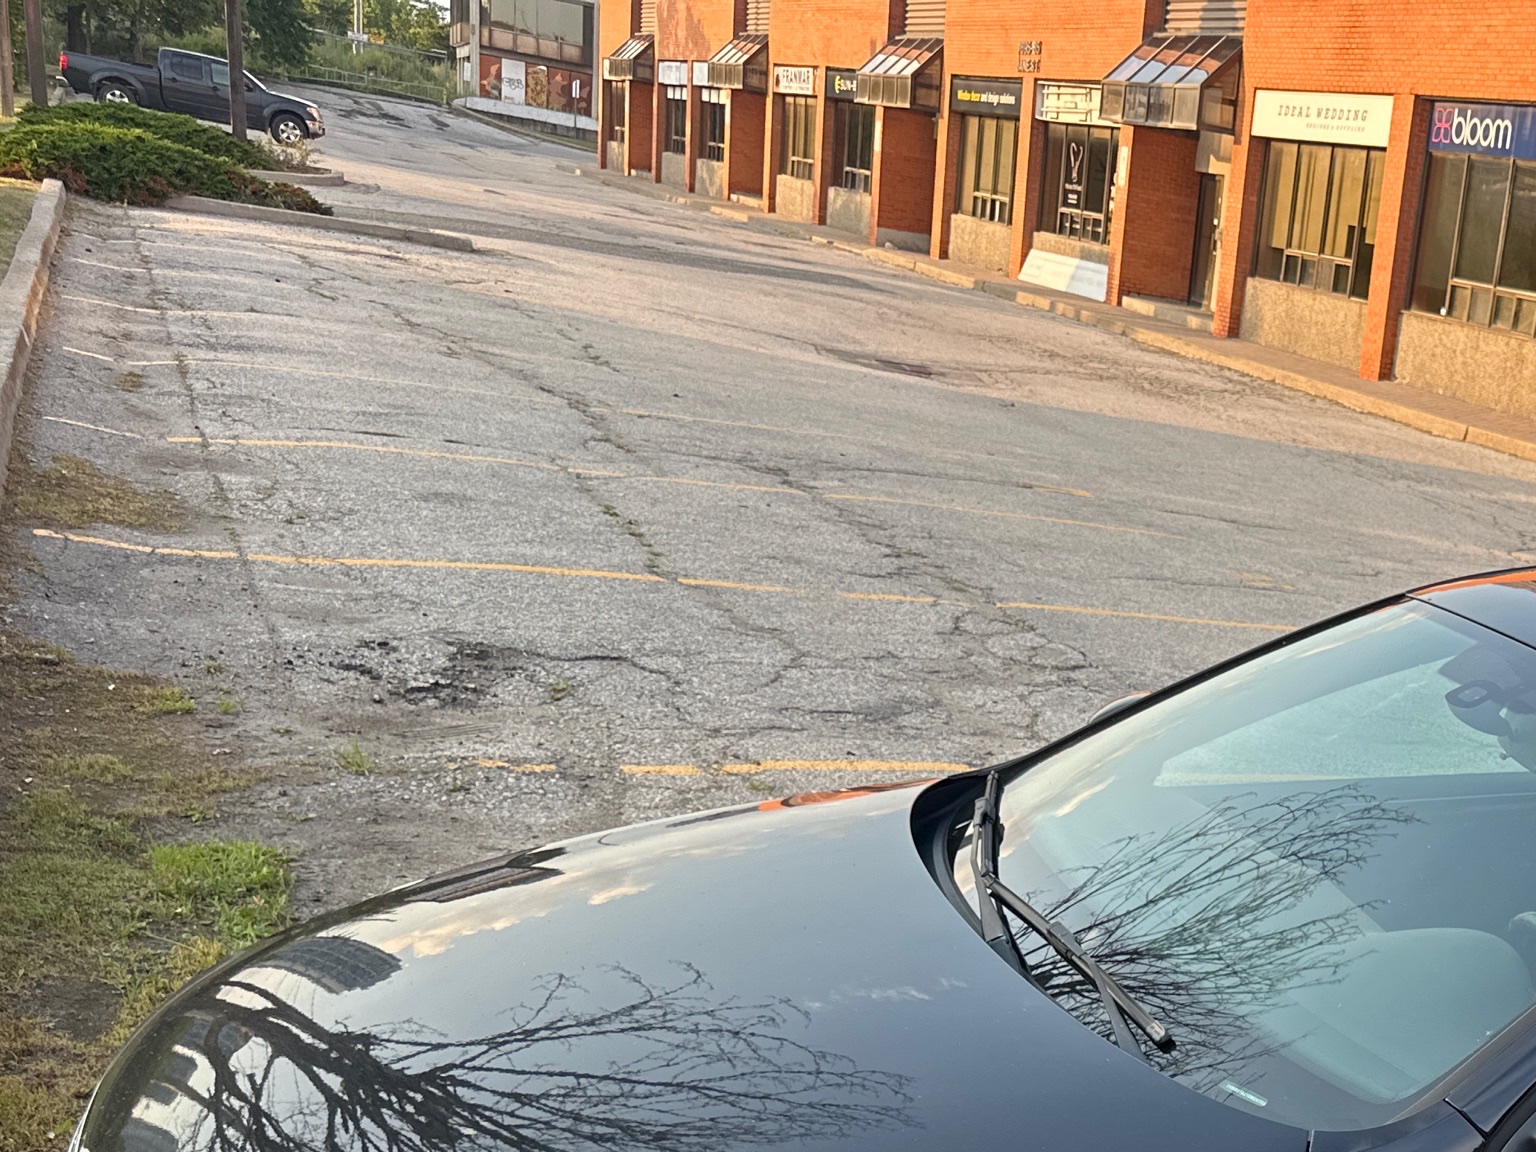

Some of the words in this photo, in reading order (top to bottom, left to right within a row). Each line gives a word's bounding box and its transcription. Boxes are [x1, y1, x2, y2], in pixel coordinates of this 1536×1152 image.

[1278, 104, 1311, 118] IDEAL
[1316, 107, 1368, 122] WEDDING
[1452, 107, 1512, 150] bloom
